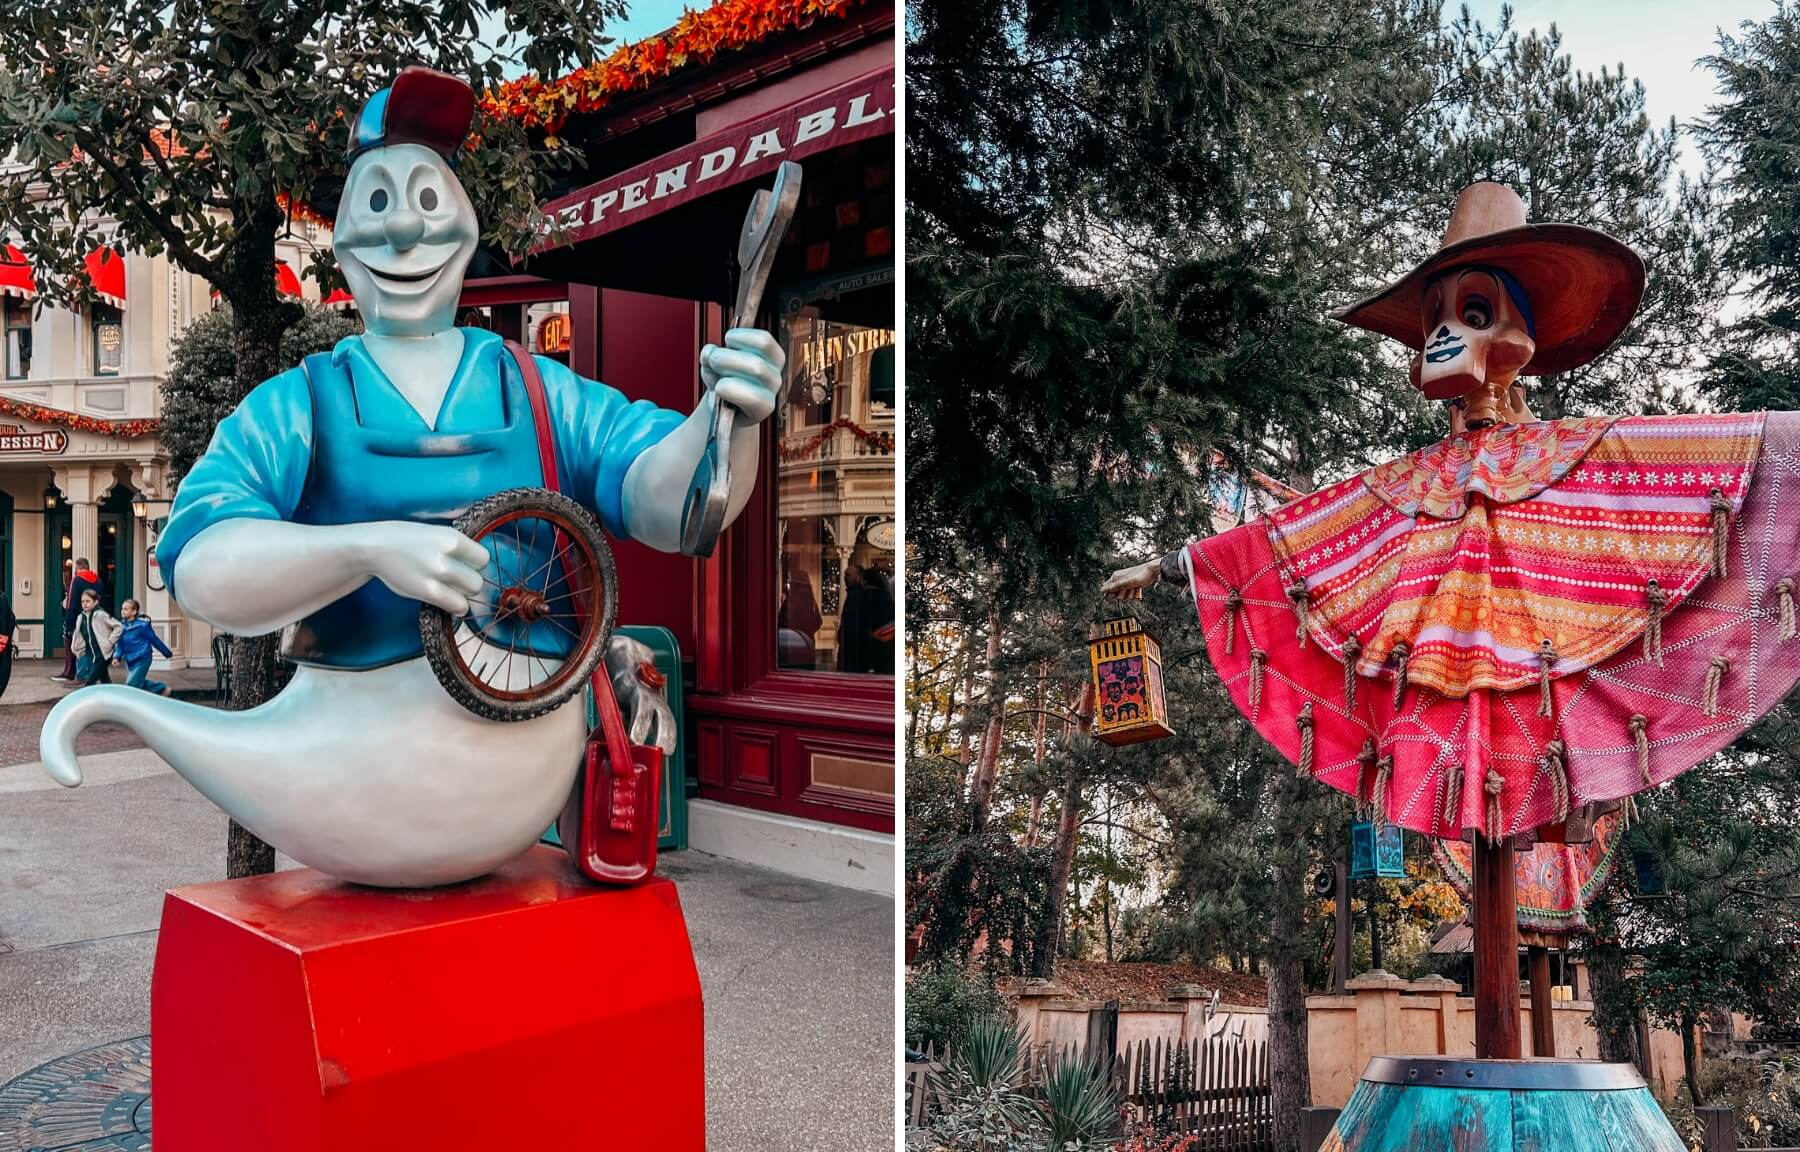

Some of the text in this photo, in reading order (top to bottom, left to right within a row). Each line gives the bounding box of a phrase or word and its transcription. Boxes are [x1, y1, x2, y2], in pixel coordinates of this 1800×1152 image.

[531, 93, 895, 236] EPENDABL
[839, 278, 863, 290] AUTO
[545, 320, 561, 352] EAT
[803, 335, 843, 381] MAIN
[0, 432, 58, 450] ESSEN
